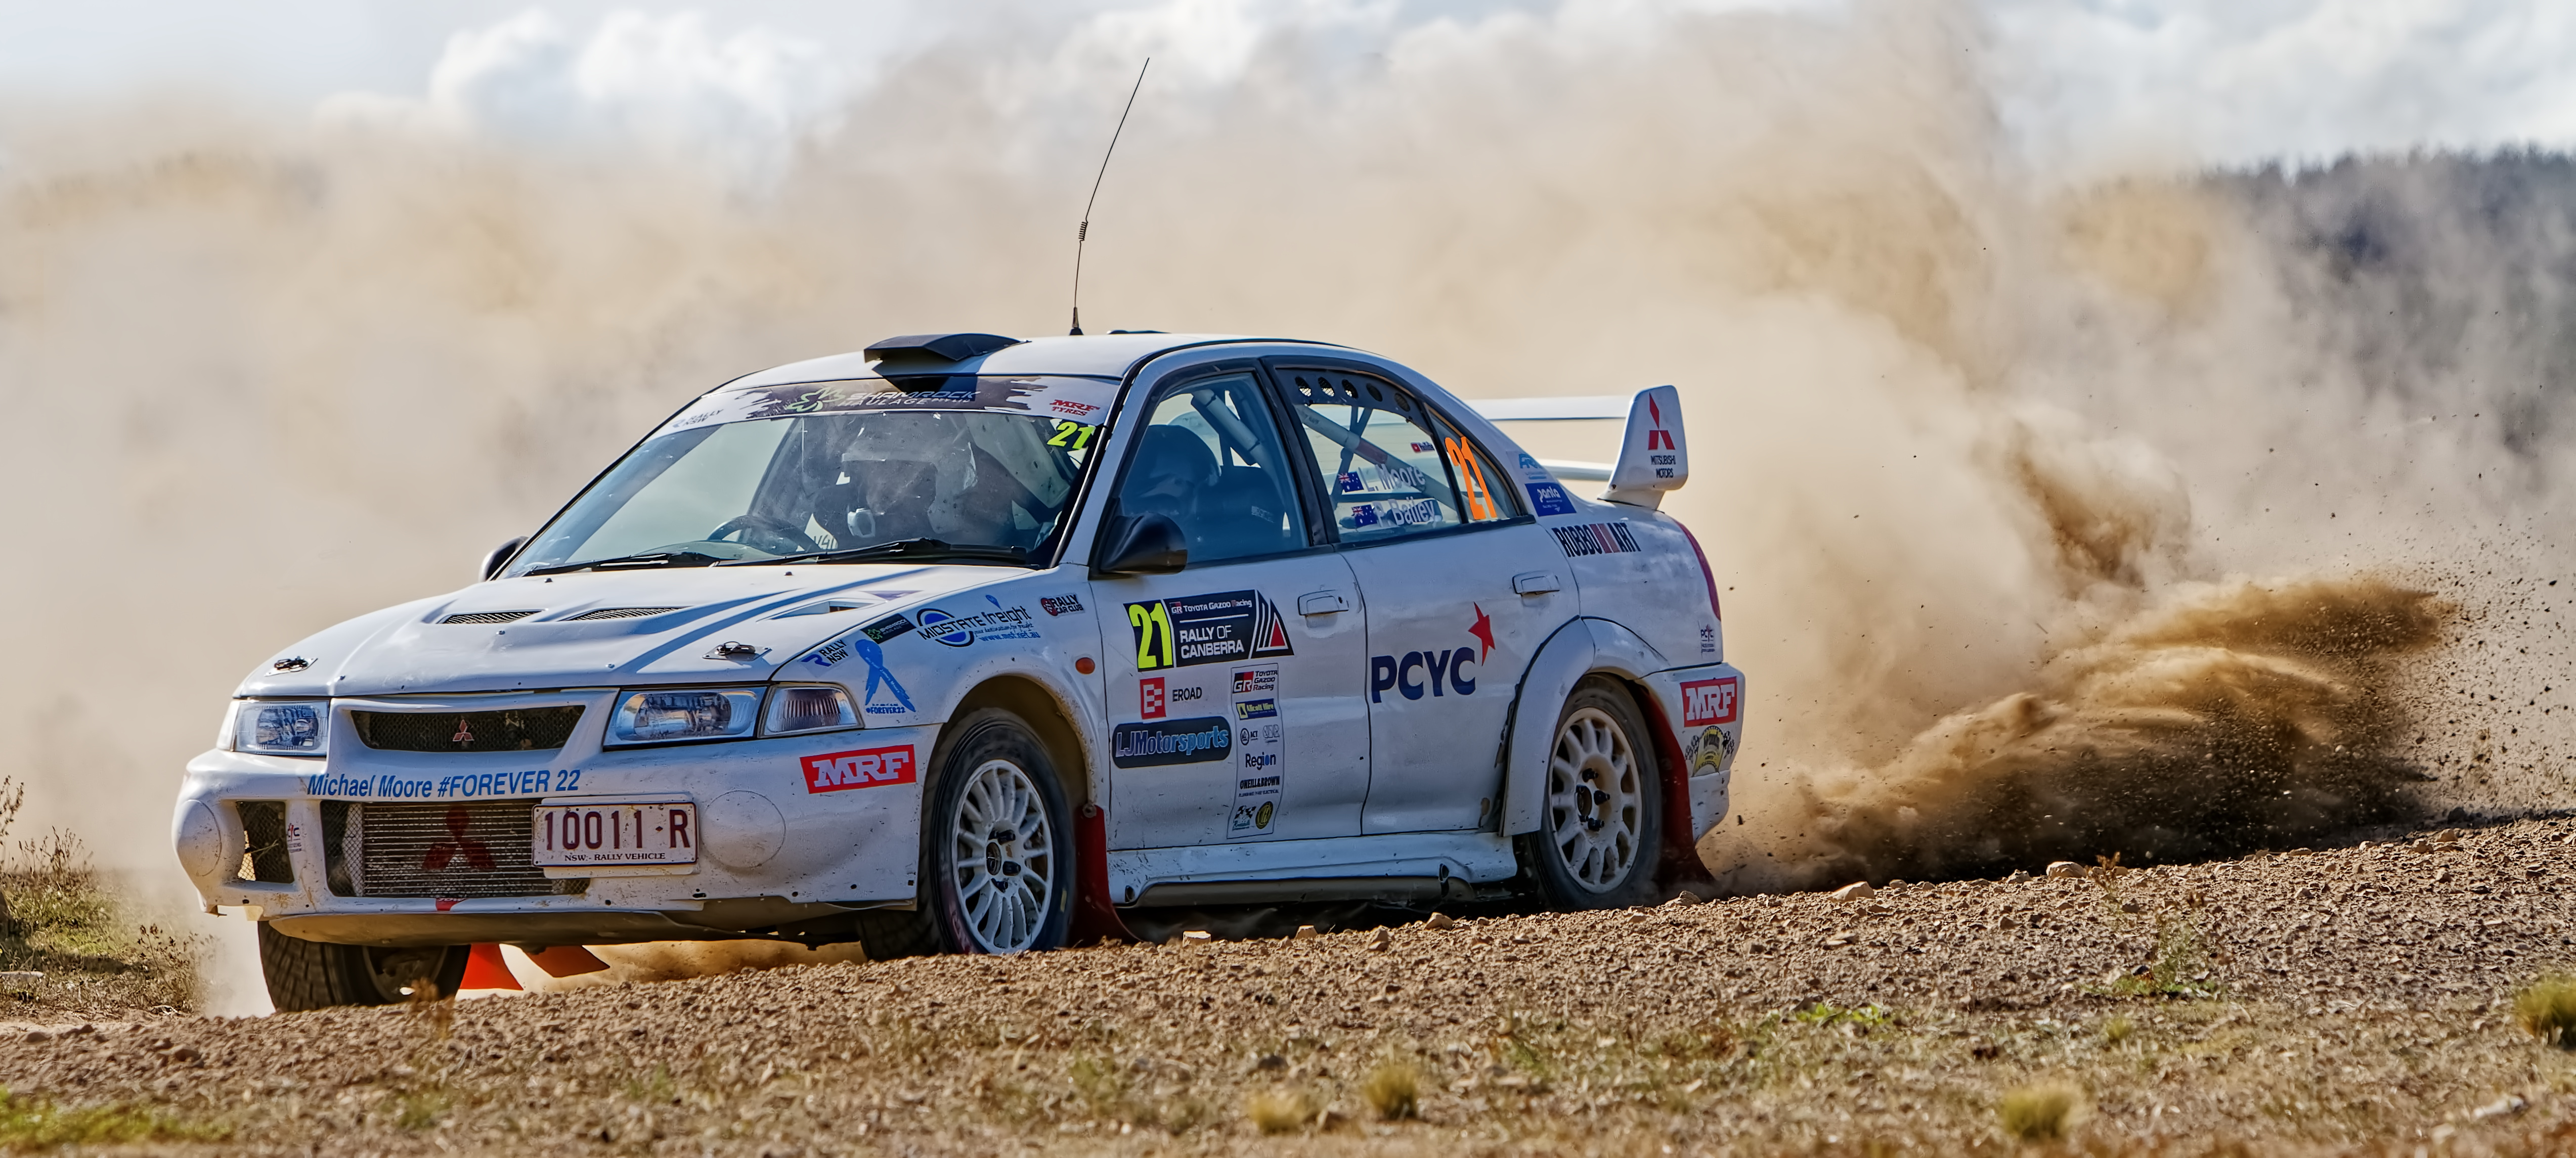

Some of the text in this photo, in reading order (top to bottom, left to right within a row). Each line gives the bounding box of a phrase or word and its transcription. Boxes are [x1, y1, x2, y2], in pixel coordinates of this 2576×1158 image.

[847, 391, 981, 400] SHAMROCK
[1050, 399, 1101, 411] MRF
[1052, 406, 1087, 416] TYRES
[1046, 421, 1096, 450] 21
[1358, 463, 1426, 492] L. Moore
[1445, 436, 1498, 520] 21
[1655, 467, 1674, 478] MOTORS
[1387, 496, 1436, 528] Bailey
[1048, 594, 1079, 607] RALLY
[1068, 604, 1084, 612] CLUB
[1183, 604, 1208, 612] TOYOTA
[916, 615, 987, 640] MIDSTATE
[981, 605, 1032, 625] freight
[1128, 602, 1173, 669] 21
[1179, 625, 1232, 644] RALLY OF
[818, 639, 847, 657] RALLY
[825, 649, 849, 664] NSW
[1181, 639, 1245, 659] CANBERRA
[1371, 647, 1476, 703] PCYC
[1172, 687, 1202, 702] EROAD
[1685, 683, 1735, 721] MRF
[1115, 725, 1229, 758] LJMotorsports
[811, 750, 910, 788] MRF
[1245, 751, 1276, 771] Region
[307, 769, 581, 798] Michael Moore #FOREVER 22
[594, 853, 623, 861] RALLY
[624, 852, 666, 861] VEHICLE
